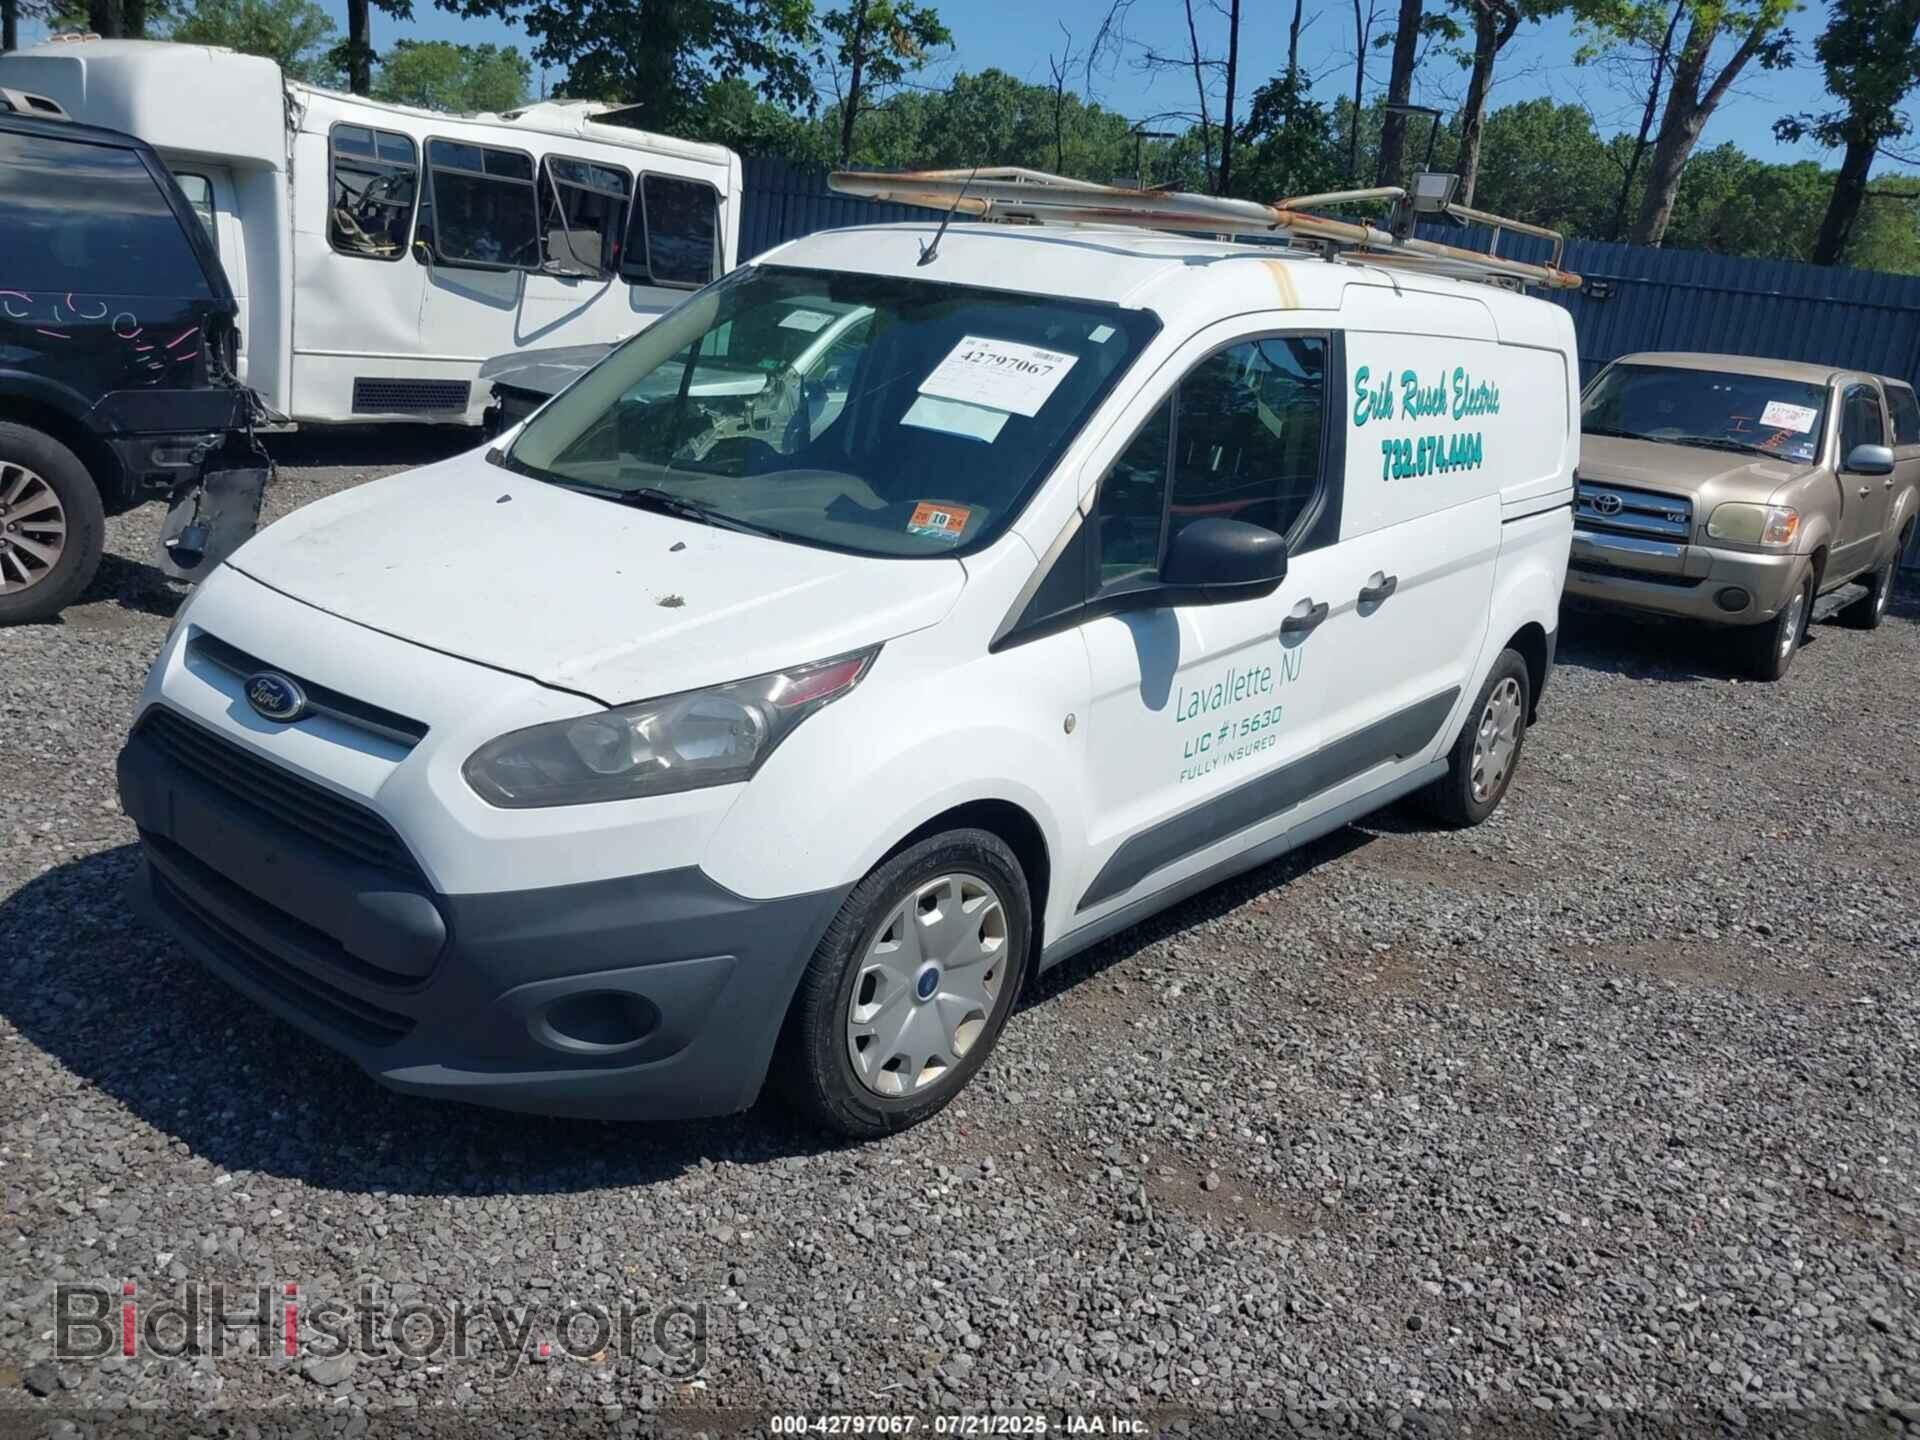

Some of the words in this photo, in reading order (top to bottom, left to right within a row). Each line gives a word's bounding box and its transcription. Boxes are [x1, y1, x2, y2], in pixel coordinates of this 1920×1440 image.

[961, 350, 1055, 377] 42797067
[1353, 365, 1394, 427] Erik
[1453, 366, 1500, 421] Electric
[1381, 431, 1483, 482] 732.674.4404
[933, 513, 947, 524] 10
[250, 679, 285, 708] Ford
[1176, 665, 1274, 723] Lavallette,
[1280, 647, 1303, 686] NJ
[1184, 732, 1212, 759] LIC
[1217, 705, 1282, 745] #15630
[1179, 758, 1219, 783] FULLY
[1223, 734, 1276, 765] INSURED
